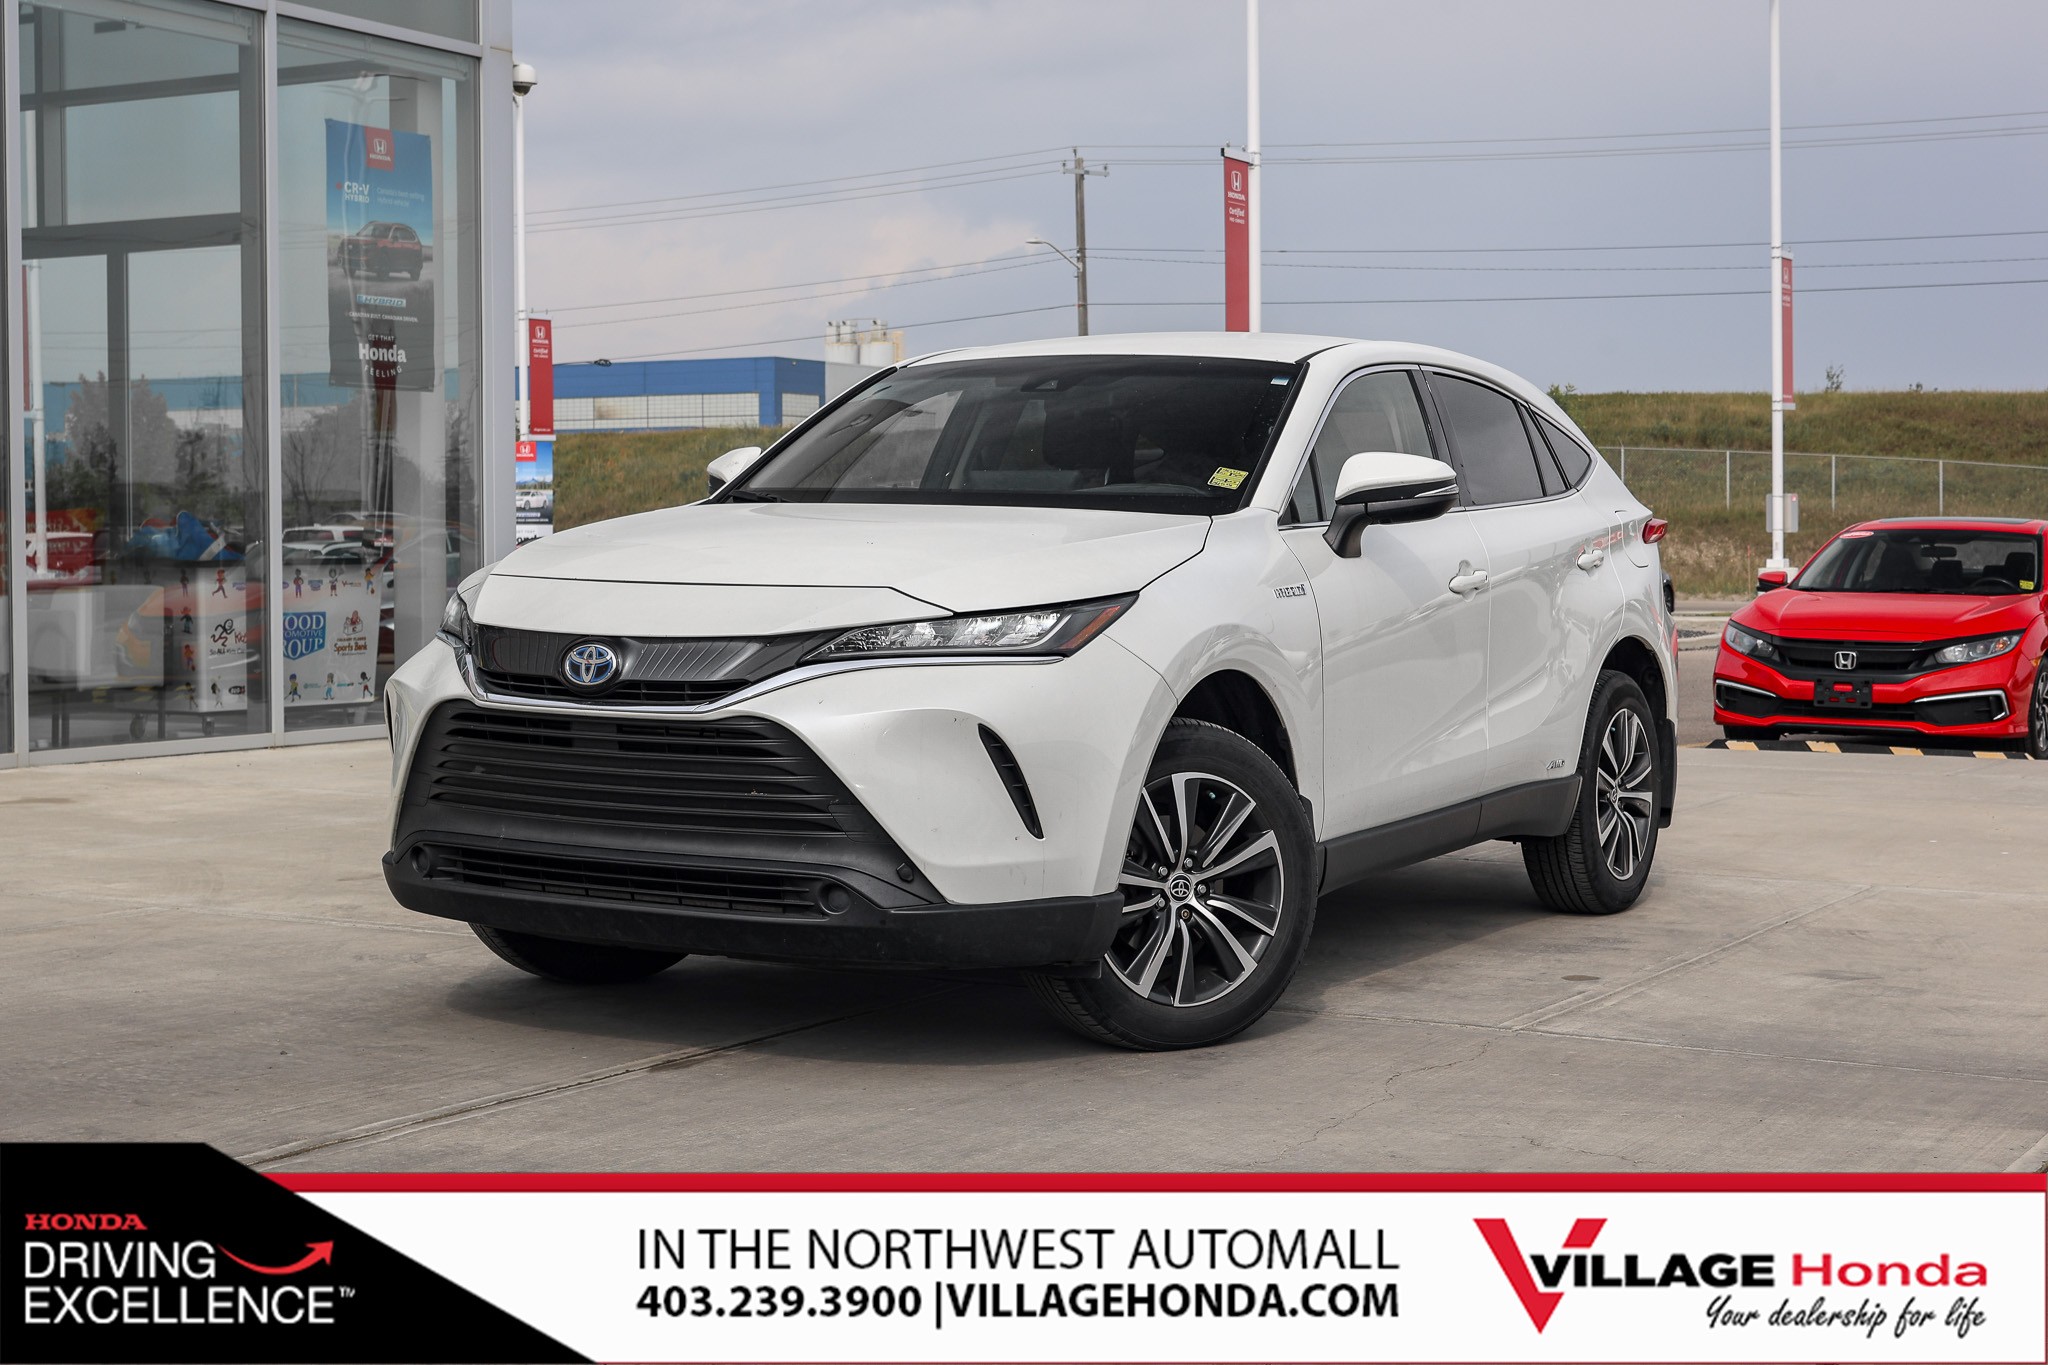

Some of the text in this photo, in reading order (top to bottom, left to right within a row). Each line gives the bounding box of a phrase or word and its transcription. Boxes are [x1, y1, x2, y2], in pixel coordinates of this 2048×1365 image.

[344, 181, 370, 196] CR-V
[1227, 191, 1245, 201] HONDA
[358, 342, 407, 363] Honda
[364, 364, 402, 377] FEELING
[283, 614, 324, 631] OOD
[284, 629, 323, 638] OMOTIVE
[334, 642, 353, 655] Sports
